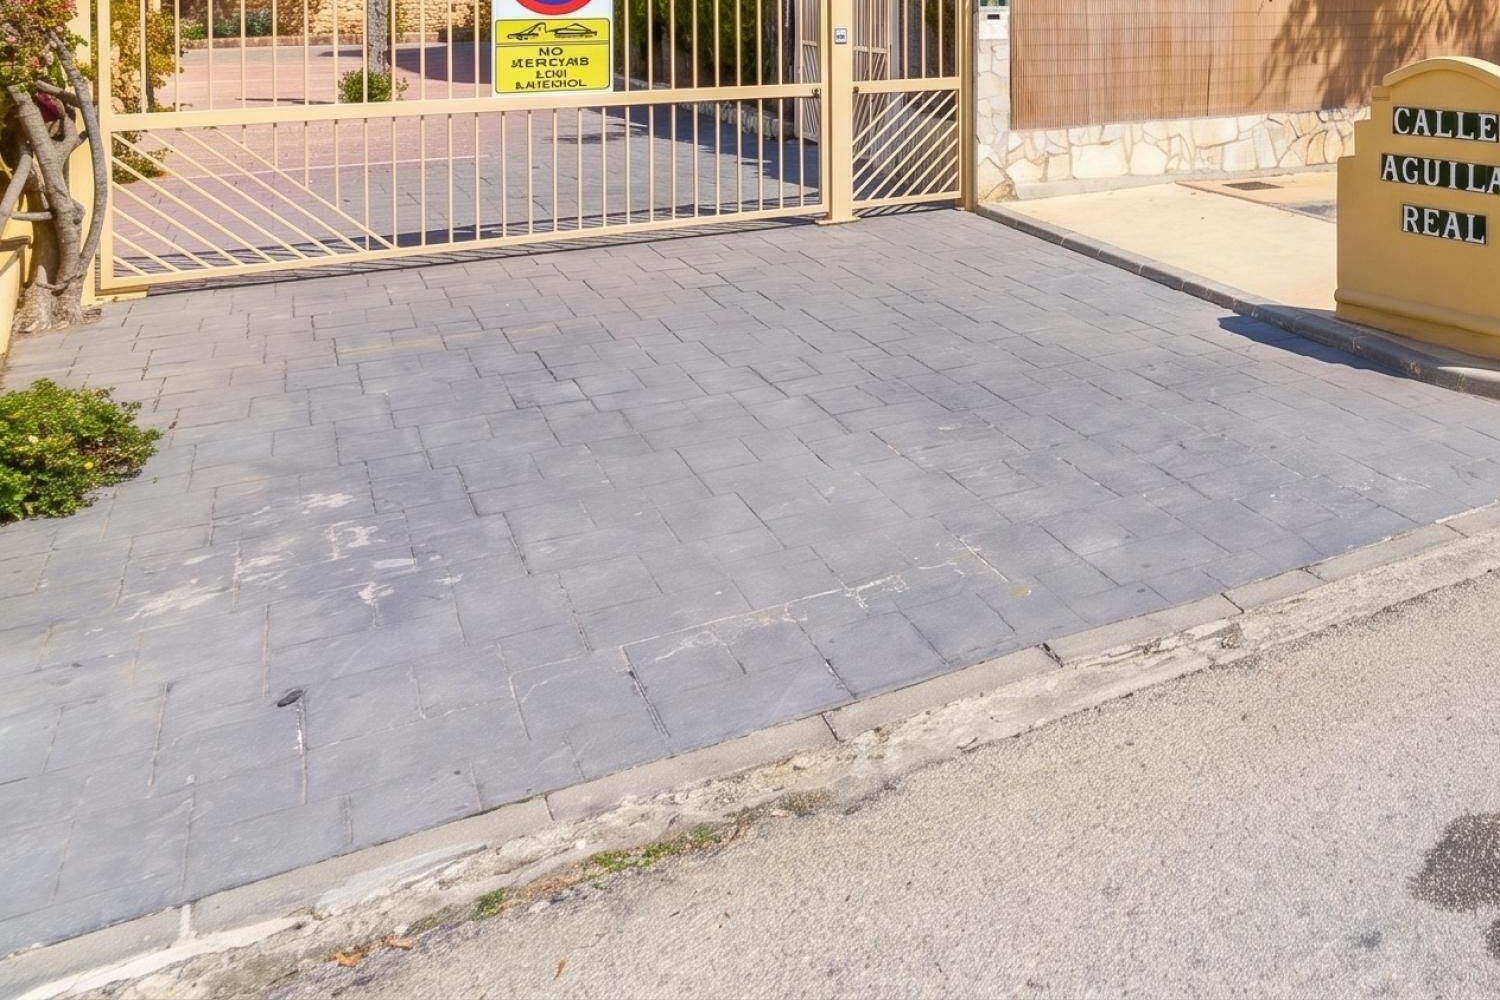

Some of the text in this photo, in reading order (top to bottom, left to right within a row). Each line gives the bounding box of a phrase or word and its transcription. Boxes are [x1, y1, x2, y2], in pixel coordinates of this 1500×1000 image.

[539, 46, 563, 56] NO
[1393, 107, 1498, 142] CALLE
[1402, 205, 1485, 244] REAL
